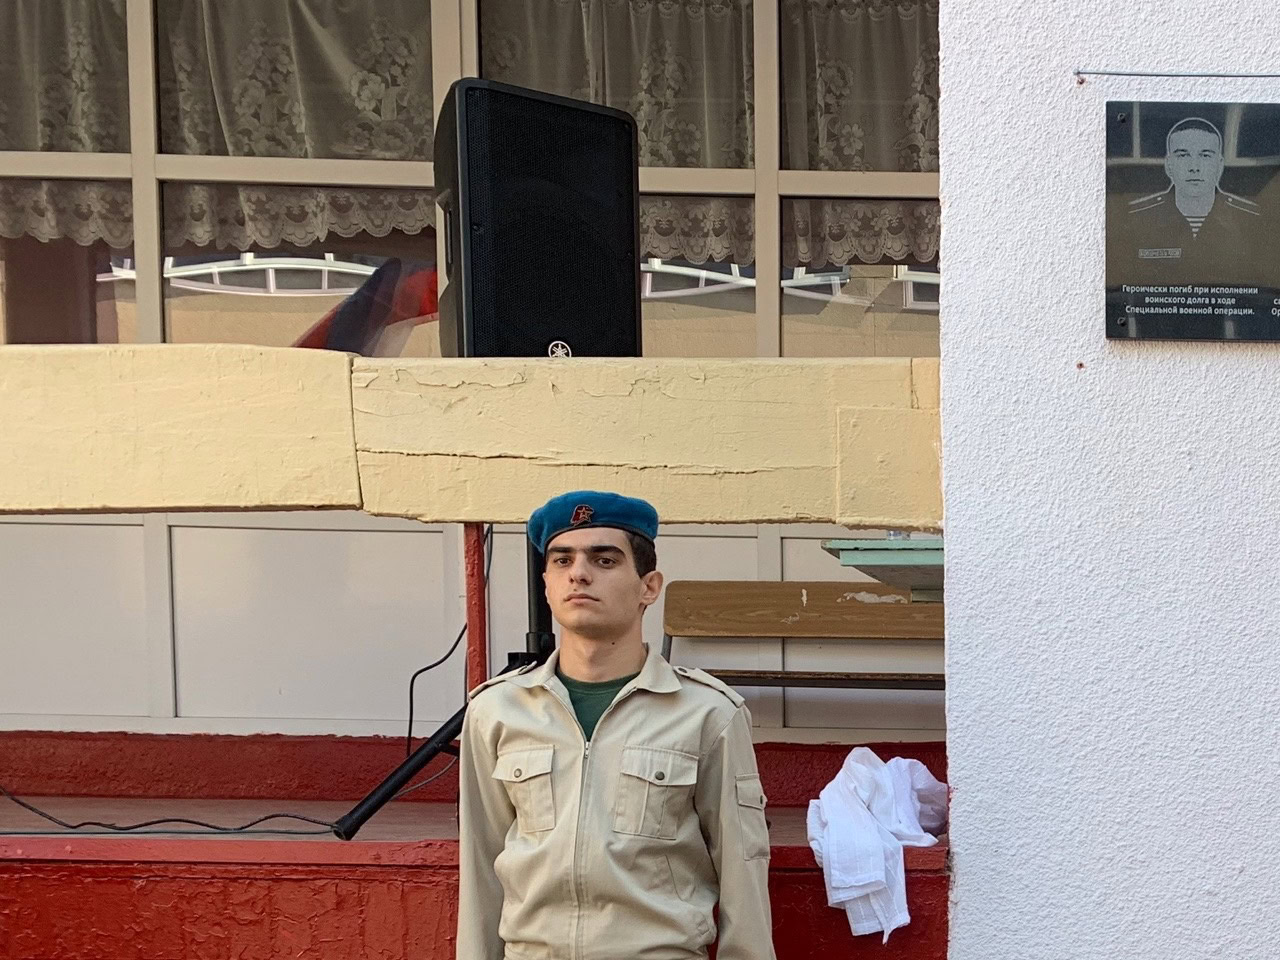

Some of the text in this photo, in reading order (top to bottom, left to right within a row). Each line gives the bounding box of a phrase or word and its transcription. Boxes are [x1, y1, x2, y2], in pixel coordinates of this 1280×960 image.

[1122, 285, 1168, 294] Героически
[1169, 285, 1193, 293] погиб
[1194, 287, 1209, 295] при
[1125, 305, 1178, 314] Специальной
[1179, 306, 1213, 314] военной
